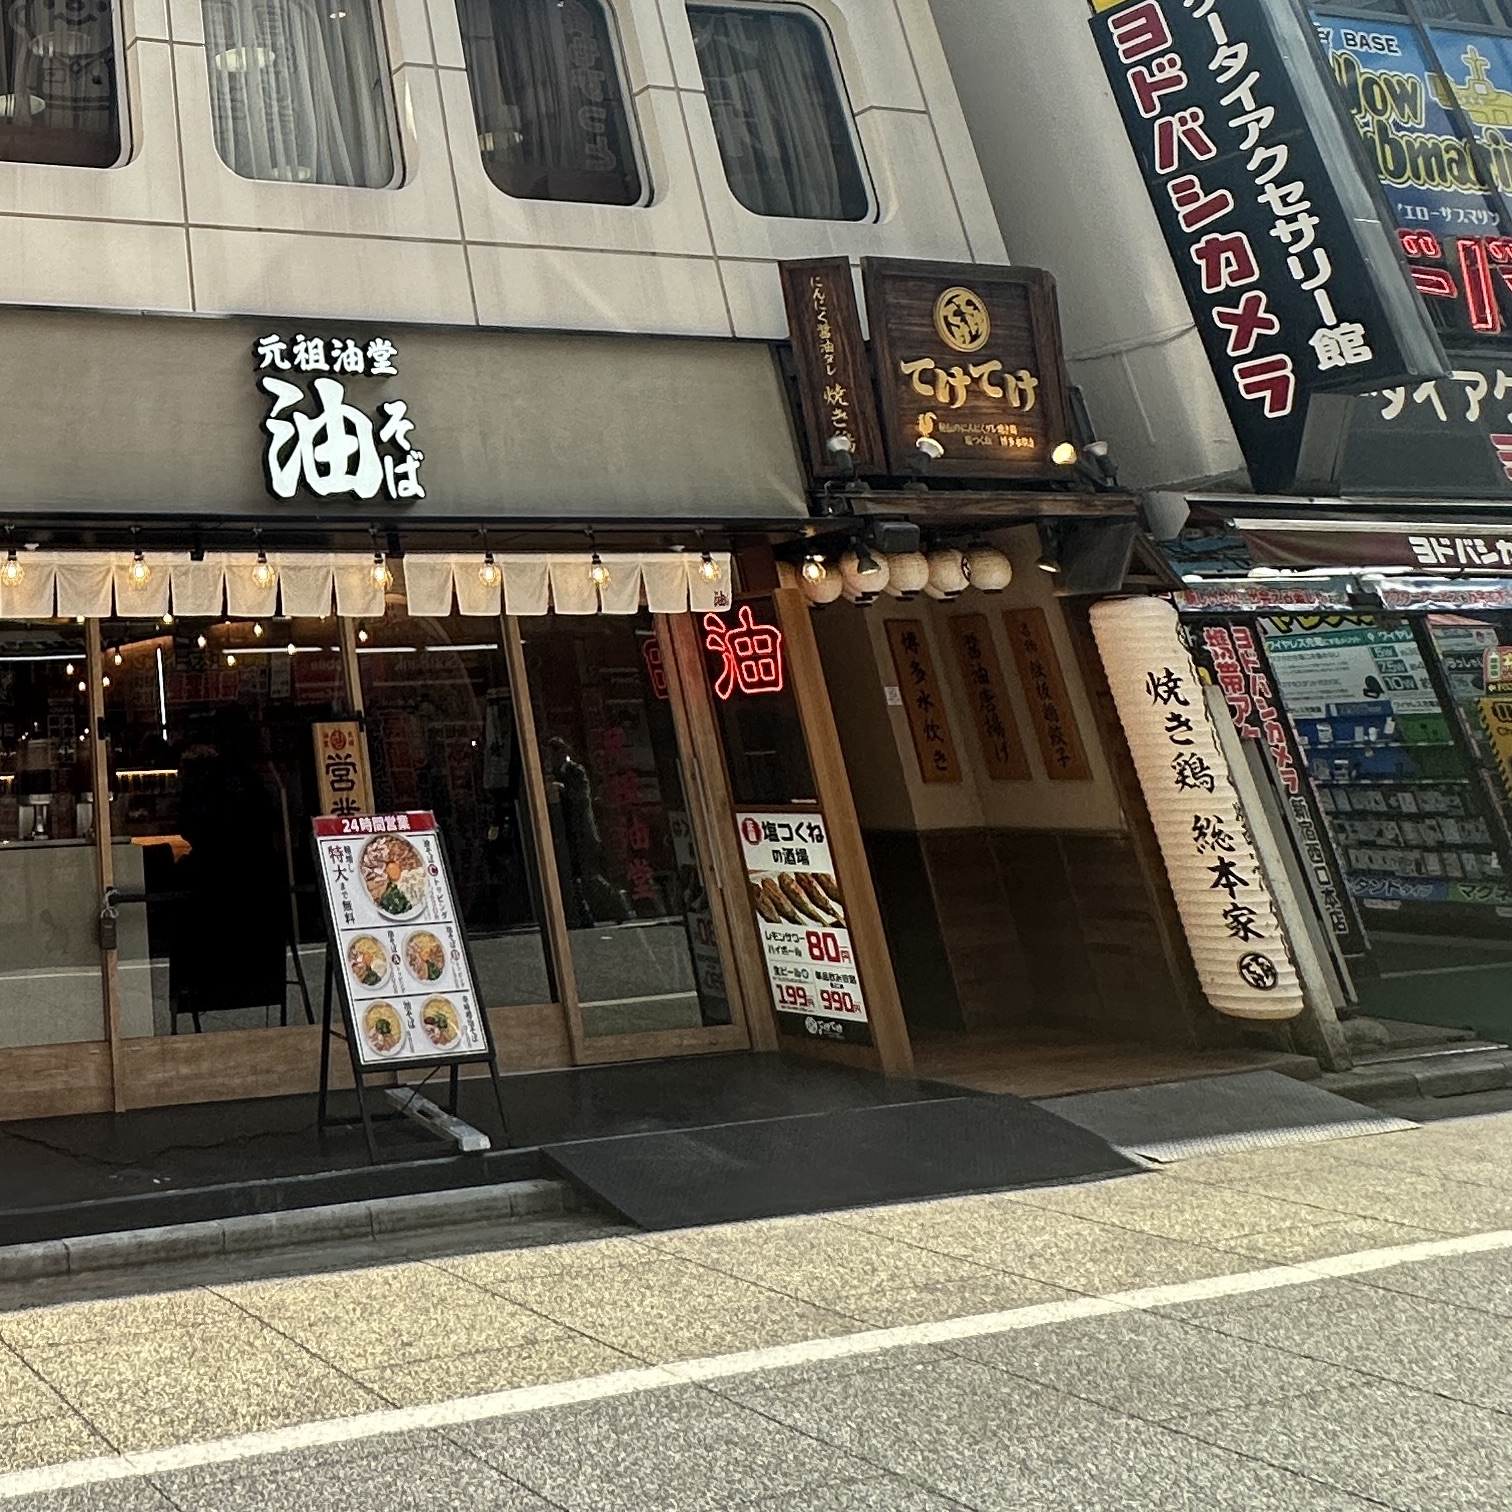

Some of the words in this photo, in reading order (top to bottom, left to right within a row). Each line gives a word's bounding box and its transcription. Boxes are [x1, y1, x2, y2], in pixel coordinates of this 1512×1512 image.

[1342, 29, 1402, 56] BASE
[1397, 201, 1501, 228] エローサブマリン
[256, 333, 399, 376] 元祖油堂
[900, 357, 1039, 413] てけてけ
[261, 377, 426, 500] 油そば
[704, 605, 783, 701] 油
[1230, 625, 1300, 795] ヨドバシカメラ
[341, 814, 411, 834] 24時間営業
[761, 820, 825, 844] 塩つくね
[1144, 667, 1217, 795] 焼き鶏
[1191, 813, 1266, 943] 総本家
[1289, 795, 1350, 935] 新宿西口本店
